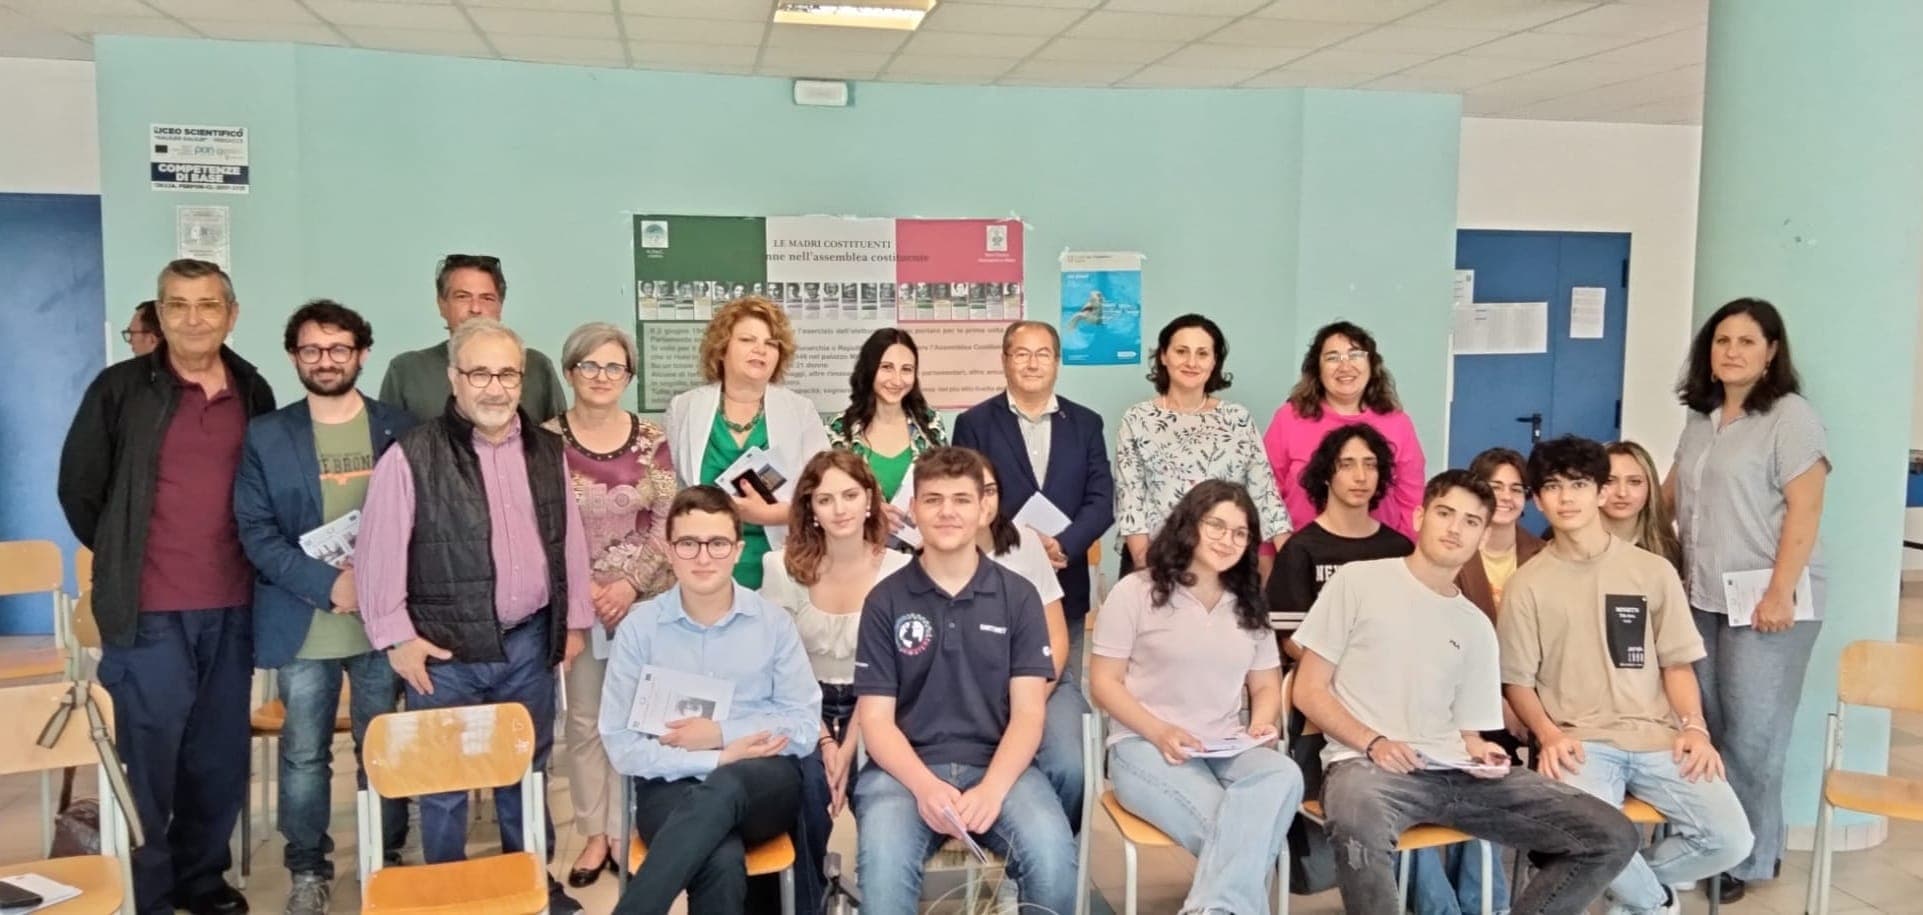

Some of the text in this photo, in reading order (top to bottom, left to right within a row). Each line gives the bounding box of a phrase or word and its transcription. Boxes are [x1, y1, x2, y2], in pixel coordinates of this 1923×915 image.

[154, 126, 182, 135] LICEO
[184, 128, 244, 138] SCIENTIFICO
[158, 163, 241, 175] COMPETENZE
[175, 173, 224, 183] DI BASE
[773, 239, 891, 249] LE MADRI COSTITUENTI
